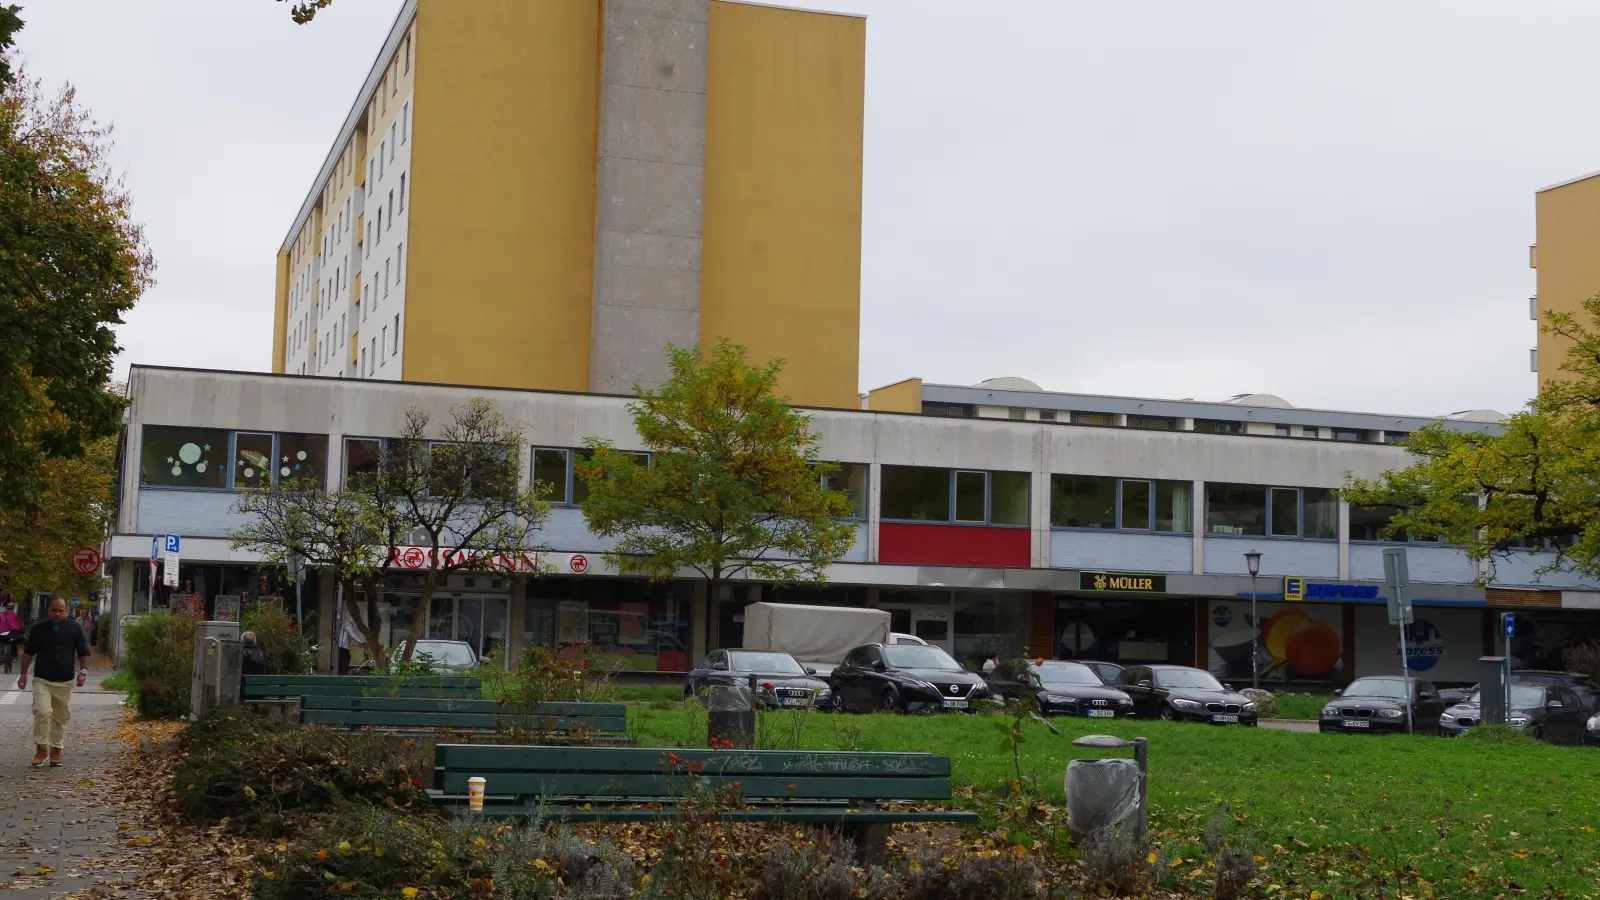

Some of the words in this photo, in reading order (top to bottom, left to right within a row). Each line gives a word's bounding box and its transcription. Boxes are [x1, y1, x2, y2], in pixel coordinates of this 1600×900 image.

[167, 536, 176, 550] P
[388, 547, 538, 572] ROSSMNN
[1109, 577, 1153, 590] MÜLLER
[1307, 584, 1380, 599] xpress
